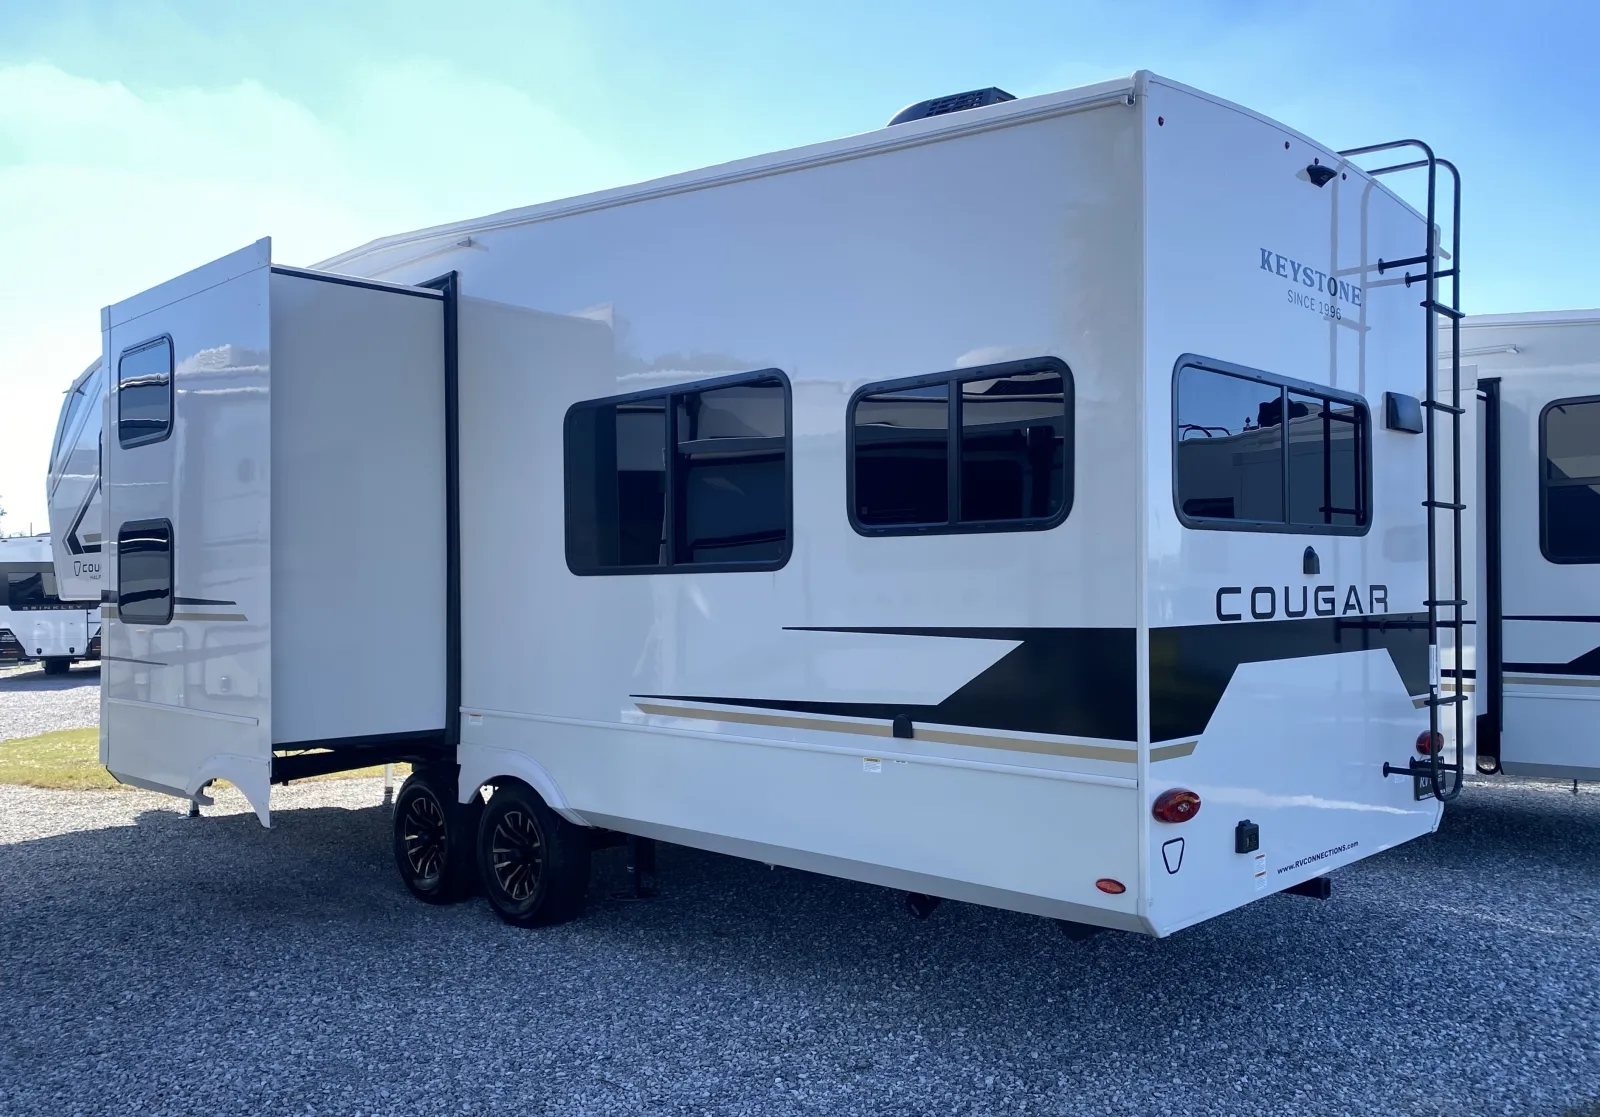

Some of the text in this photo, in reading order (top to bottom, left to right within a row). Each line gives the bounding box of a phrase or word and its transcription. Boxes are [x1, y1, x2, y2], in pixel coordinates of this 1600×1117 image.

[1260, 247, 1362, 308] KEYSTONE
[1287, 289, 1342, 321] SINCE 1996
[1216, 584, 1388, 622] COUGAR
[1277, 841, 1359, 875] www.RVCONNECTIONS.com
